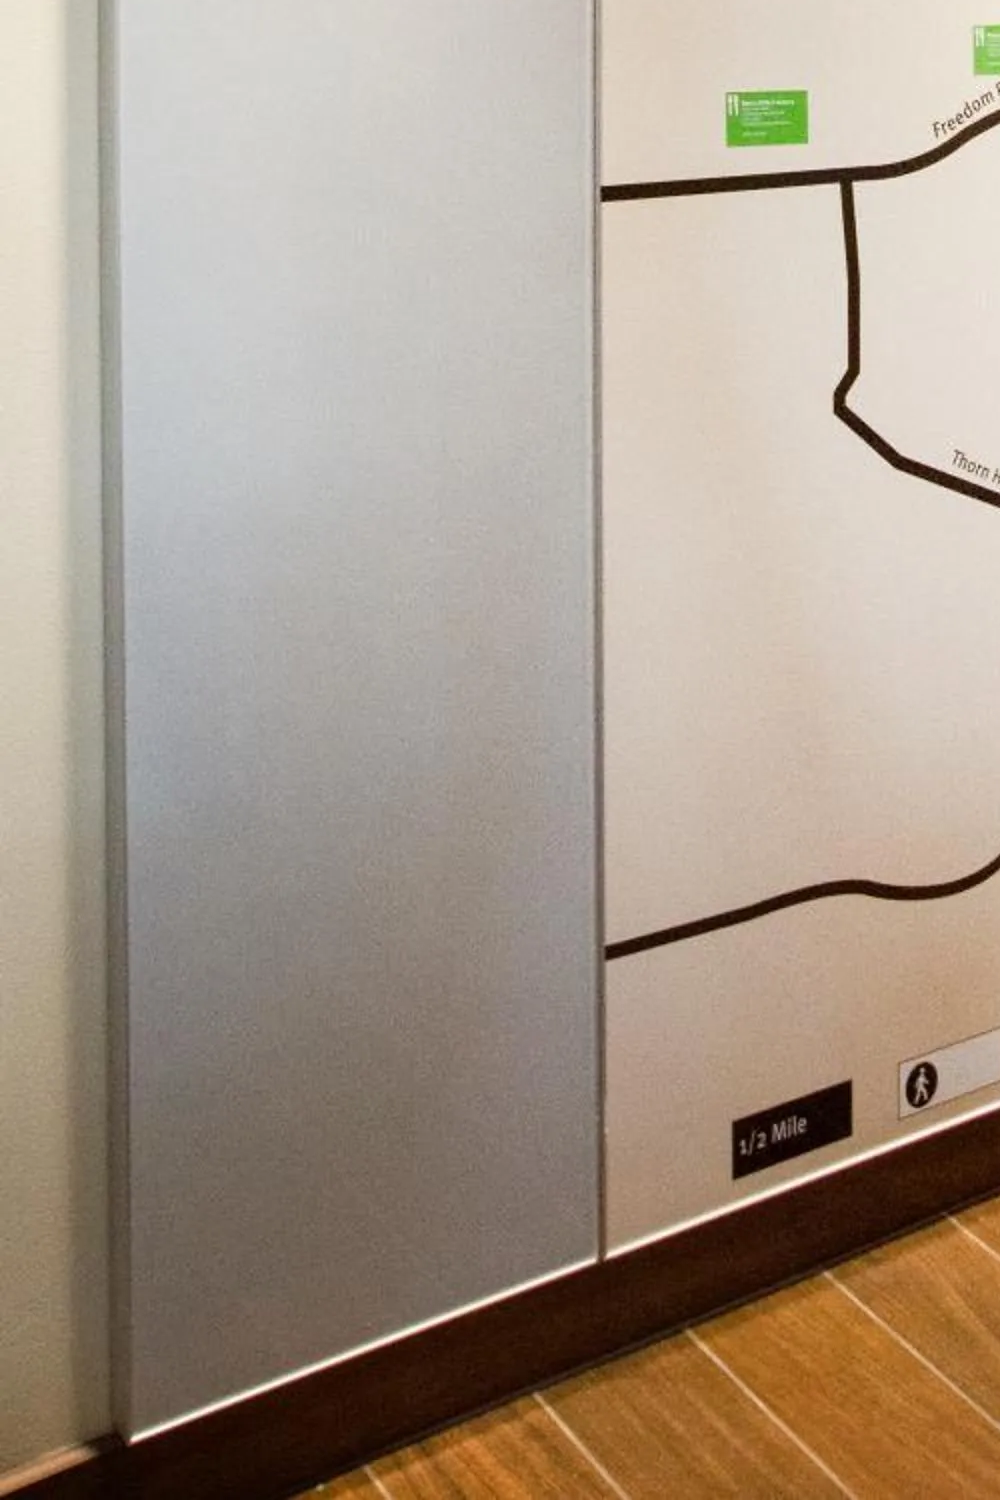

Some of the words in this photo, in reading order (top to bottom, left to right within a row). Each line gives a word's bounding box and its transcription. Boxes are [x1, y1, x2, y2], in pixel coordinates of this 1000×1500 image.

[932, 89, 996, 138] Freedom
[952, 448, 990, 480] Thorn
[738, 1130, 768, 1158] 1/2
[771, 1115, 808, 1146] Mile
